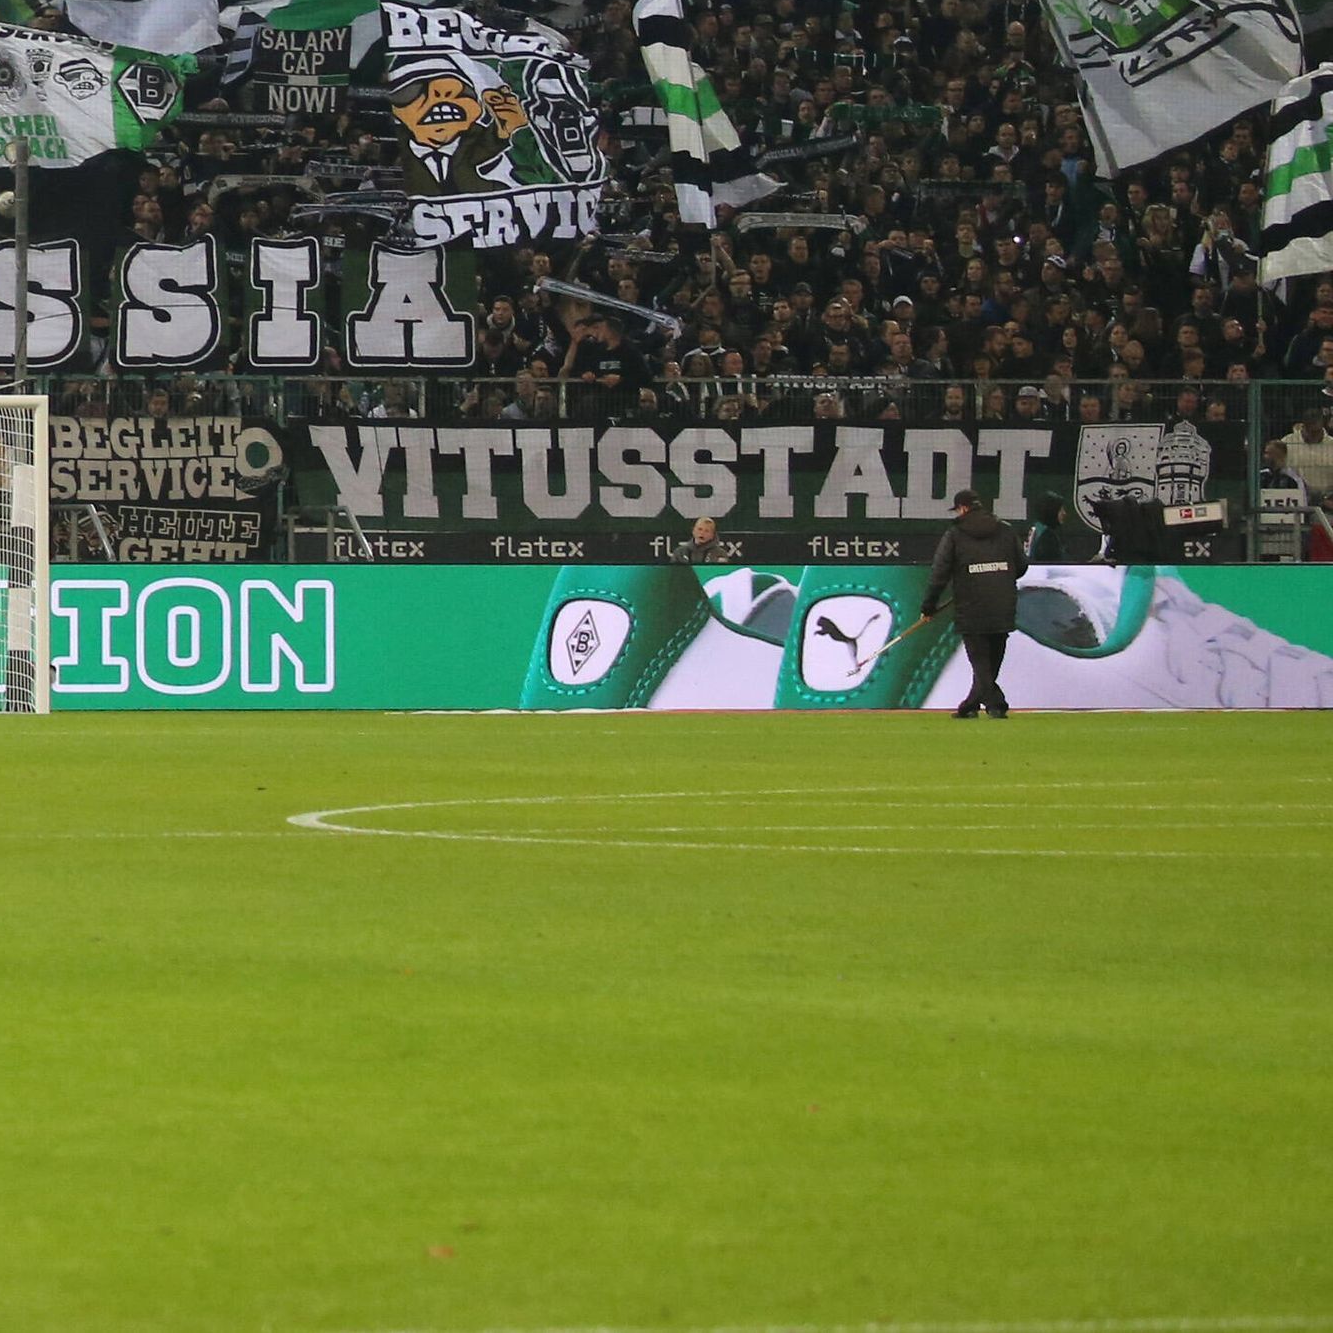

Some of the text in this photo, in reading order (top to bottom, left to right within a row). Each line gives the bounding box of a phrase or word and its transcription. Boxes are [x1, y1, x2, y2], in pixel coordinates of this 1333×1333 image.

[261, 27, 347, 51] SALARY
[281, 52, 325, 76] CAP
[268, 86, 336, 114] NOW!
[50, 416, 242, 459] BEGLEIT
[50, 457, 235, 501] SERVICE
[307, 424, 1054, 524] VITUSSTADT
[118, 505, 262, 548] HEUTE
[118, 537, 248, 562] GEHT
[334, 536, 425, 559] flatex
[490, 536, 585, 559] flatex
[649, 536, 744, 559] flx
[807, 535, 900, 557] flatex
